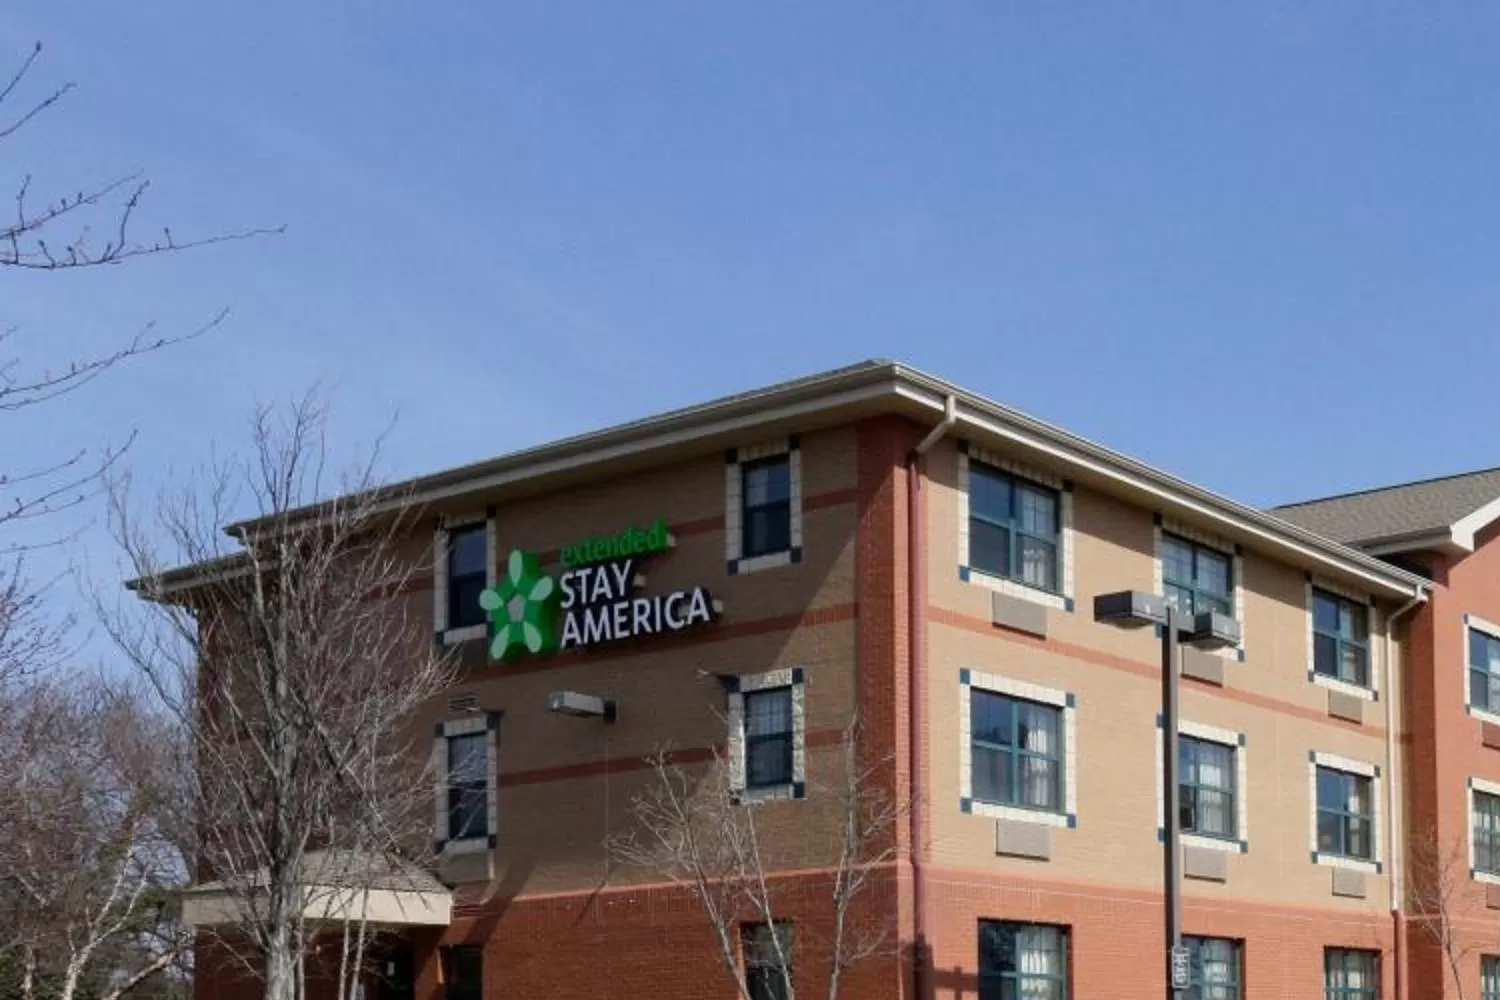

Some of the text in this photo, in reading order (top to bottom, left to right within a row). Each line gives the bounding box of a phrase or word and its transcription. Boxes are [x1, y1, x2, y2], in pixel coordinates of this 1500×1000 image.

[560, 519, 668, 567] extended
[560, 558, 633, 609] STAY
[560, 587, 711, 649] AMERICA
